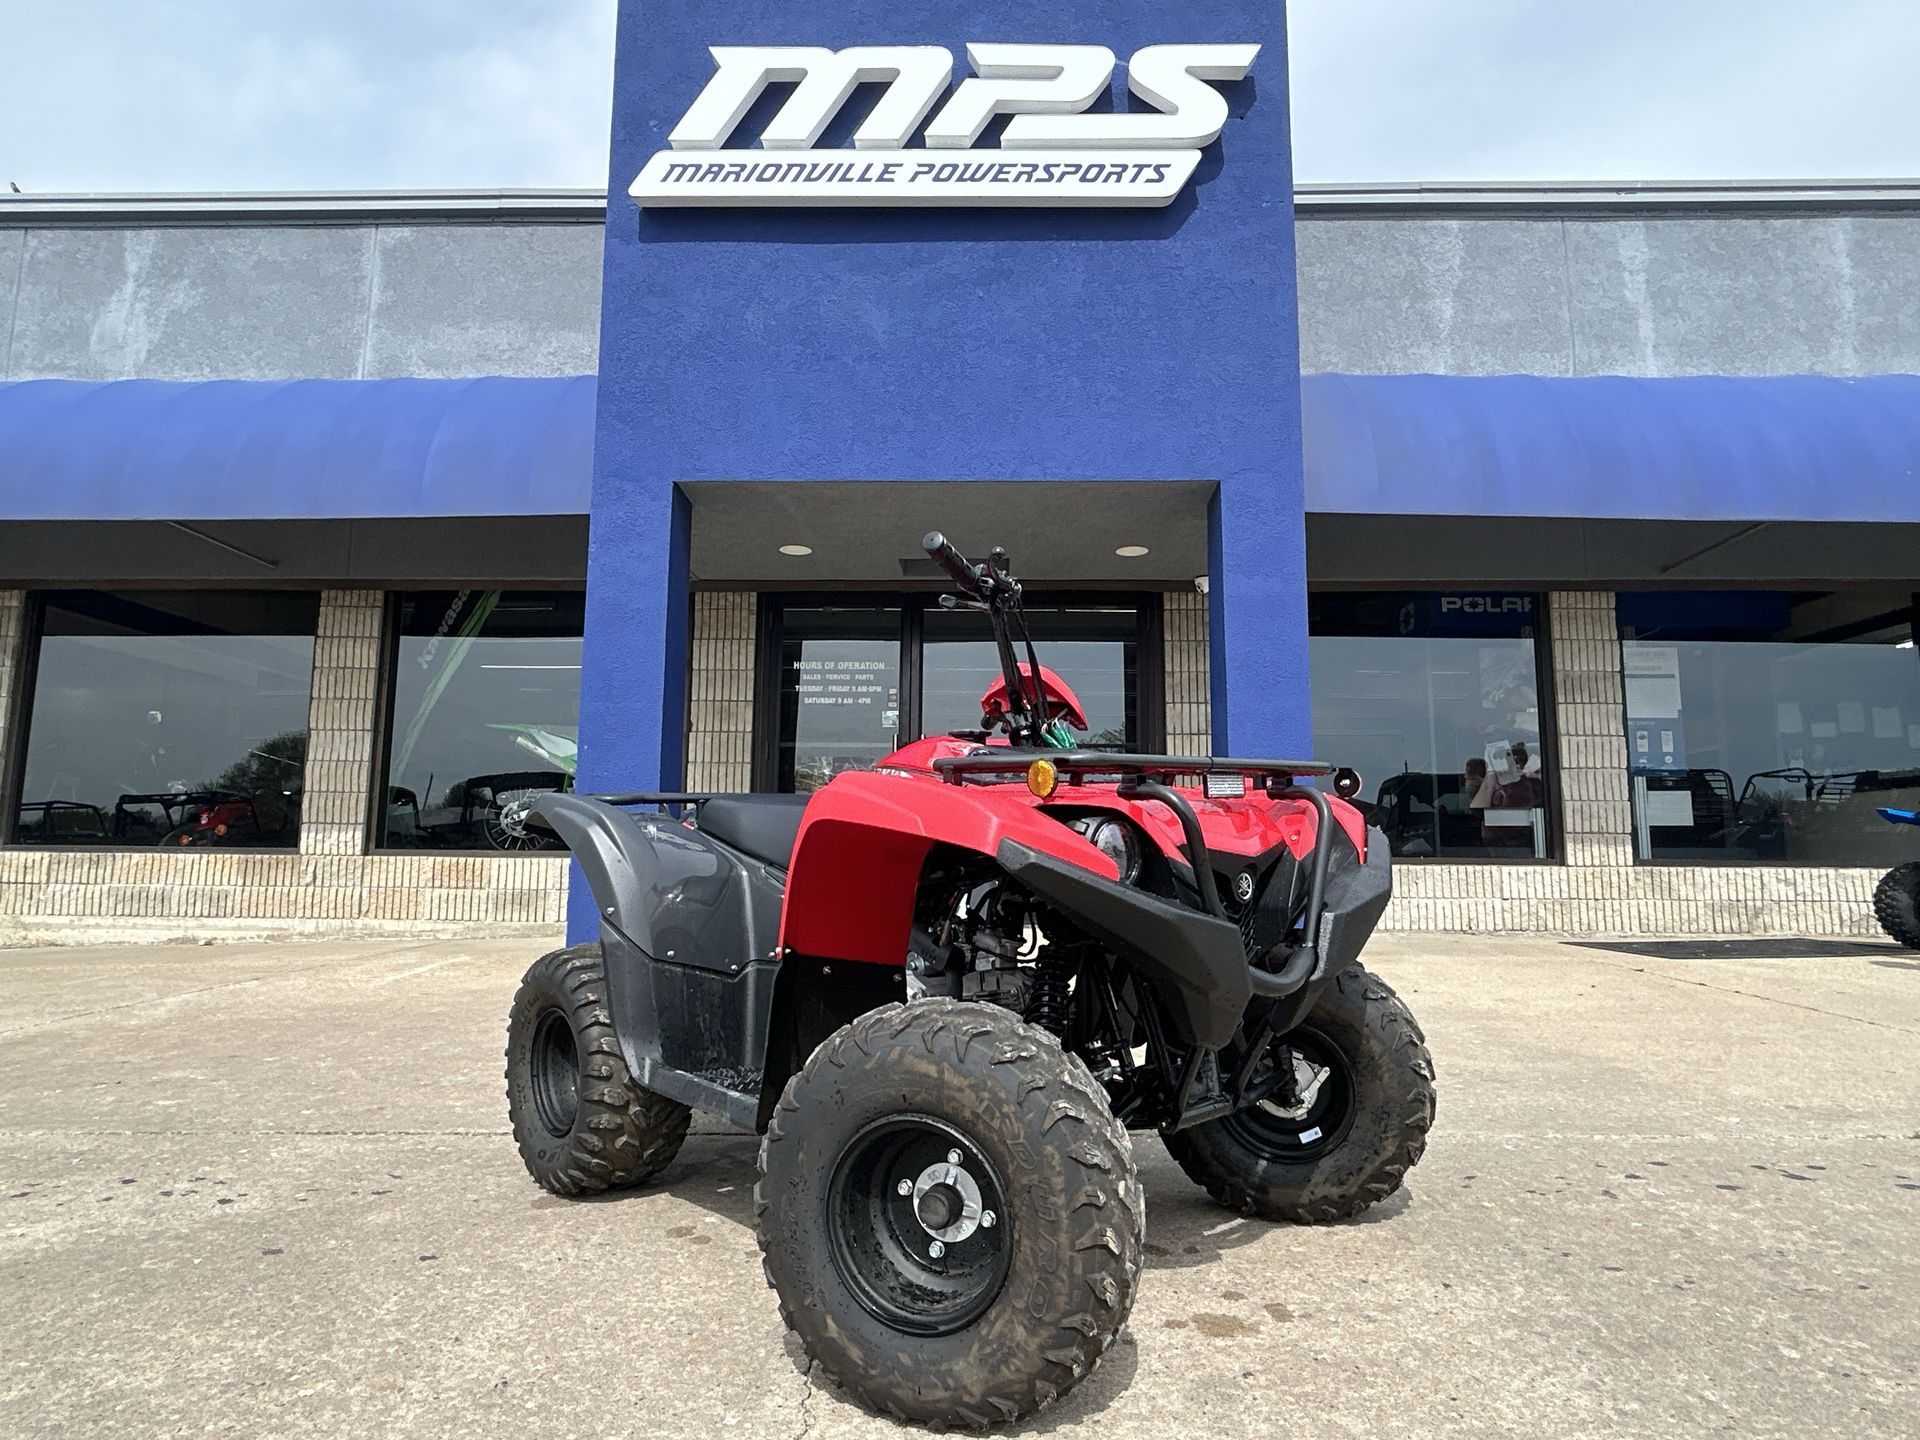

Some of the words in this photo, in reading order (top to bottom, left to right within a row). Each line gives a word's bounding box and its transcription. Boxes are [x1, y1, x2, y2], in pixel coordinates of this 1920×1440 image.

[669, 43, 1262, 149] MPS
[660, 162, 903, 183] MARIONVILLE
[908, 162, 1171, 184] POWERSPORTS
[793, 661, 822, 670] HOURS
[824, 661, 836, 670] OF
[837, 661, 885, 670] OPERATION
